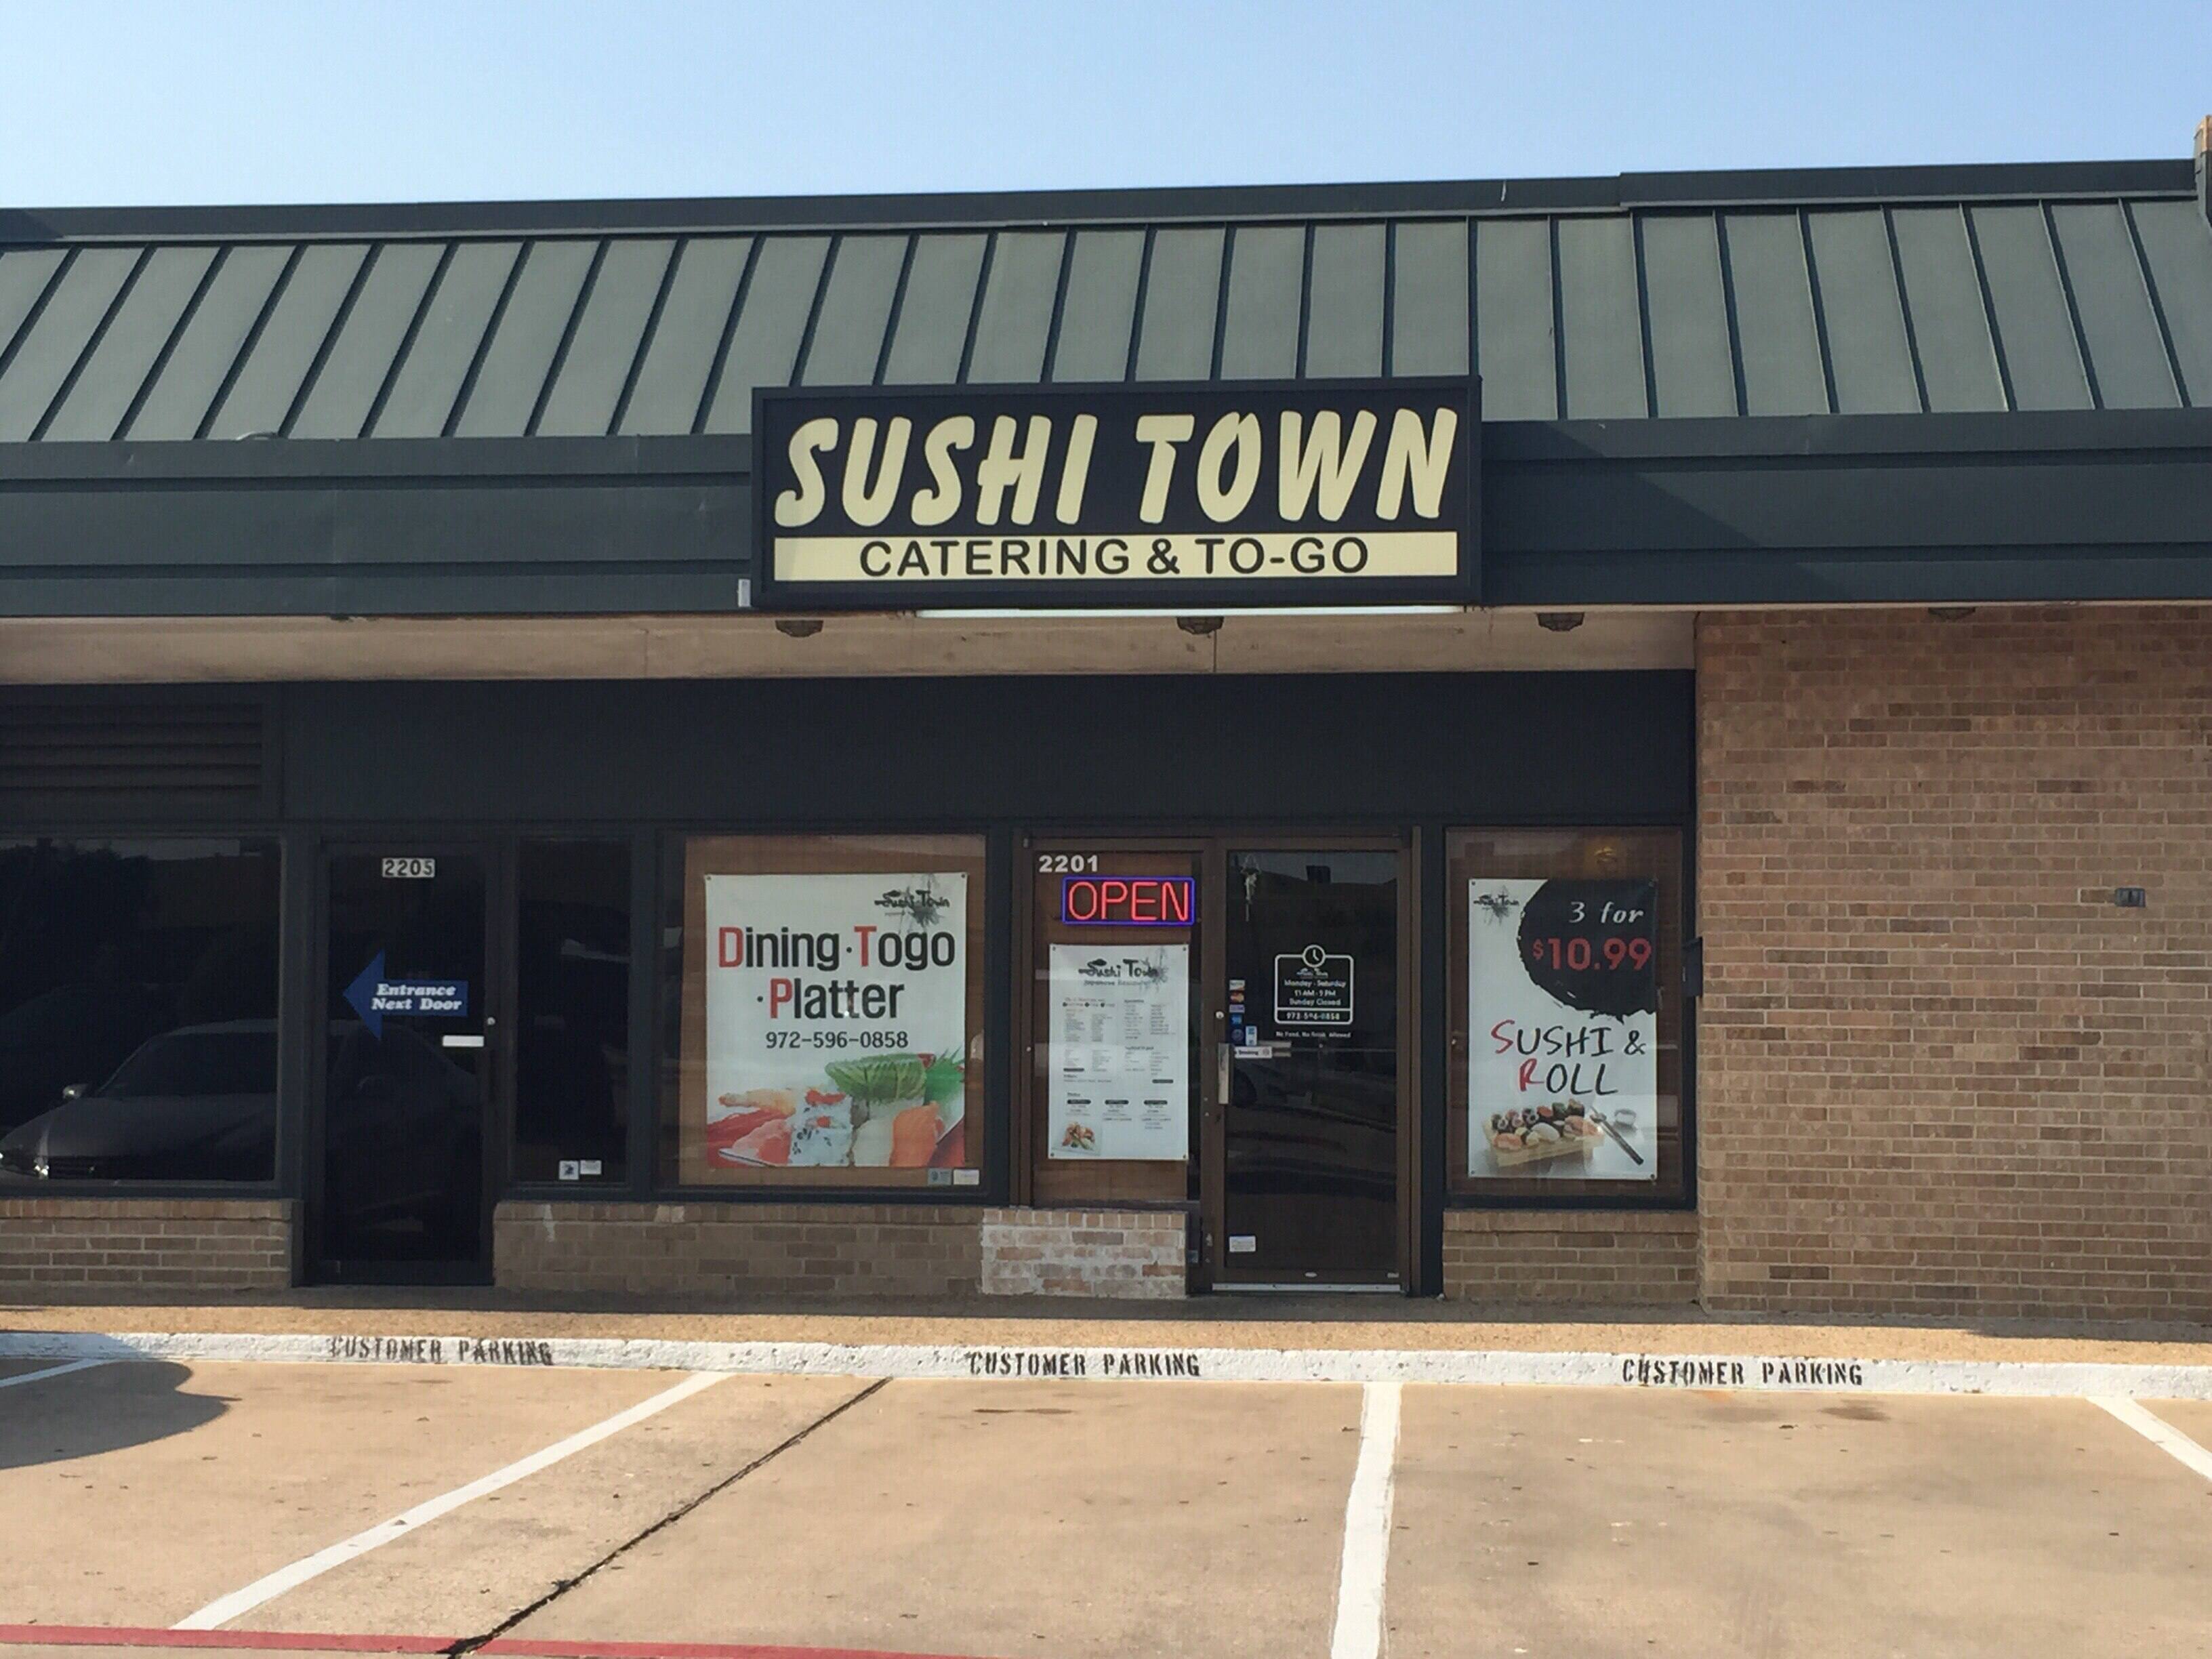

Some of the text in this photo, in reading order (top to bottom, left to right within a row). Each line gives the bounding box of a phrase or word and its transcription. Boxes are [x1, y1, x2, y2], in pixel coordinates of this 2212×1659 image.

[774, 407, 1458, 527] SUSHI TOWN
[859, 536, 1370, 578] CATERING & TO-GO
[384, 859, 434, 876] 2205
[1038, 855, 1099, 873] 2201
[1068, 881, 1189, 921] OPEN
[1569, 901, 1644, 924] 3 for
[718, 926, 840, 971] Dining
[1532, 937, 1652, 971] $10.99
[371, 998, 463, 1010] Next Door
[375, 983, 456, 996] Entrance
[770, 978, 905, 1019] Platter
[766, 1030, 908, 1049] 972-596-0858
[1490, 1019, 1646, 1057] SUSHI &
[1517, 1058, 1619, 1095] ROLL
[327, 1336, 554, 1366] CUSTOMER PARKING
[968, 1351, 1201, 1377] CUSTOMER PARKING
[1622, 1358, 1863, 1386] CUSTOMER PARKING
